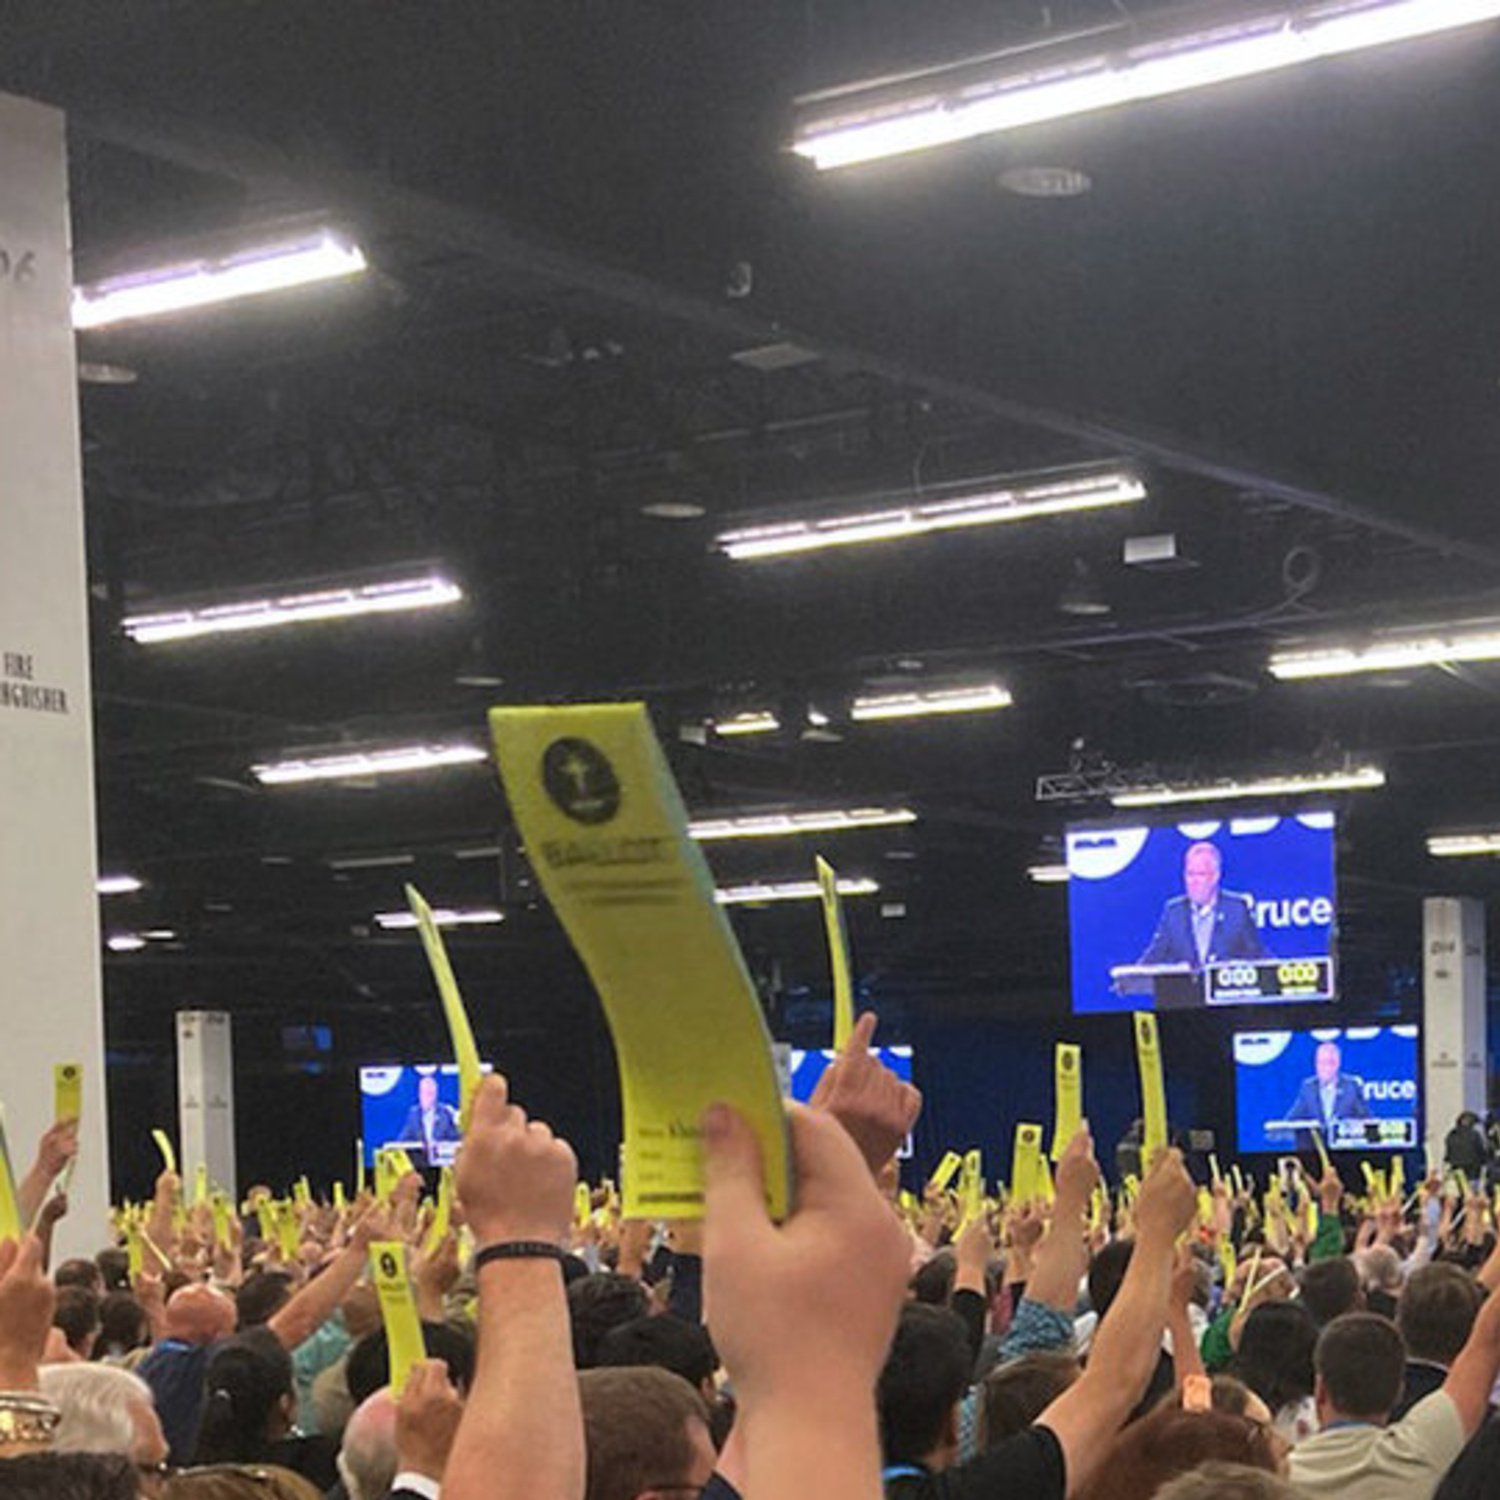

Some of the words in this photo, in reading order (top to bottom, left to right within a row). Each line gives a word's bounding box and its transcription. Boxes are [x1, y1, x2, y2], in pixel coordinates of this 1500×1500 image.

[4, 652, 33, 680] FIRE
[1243, 894, 1334, 928] ruce
[1355, 1076, 1417, 1100] ruce
